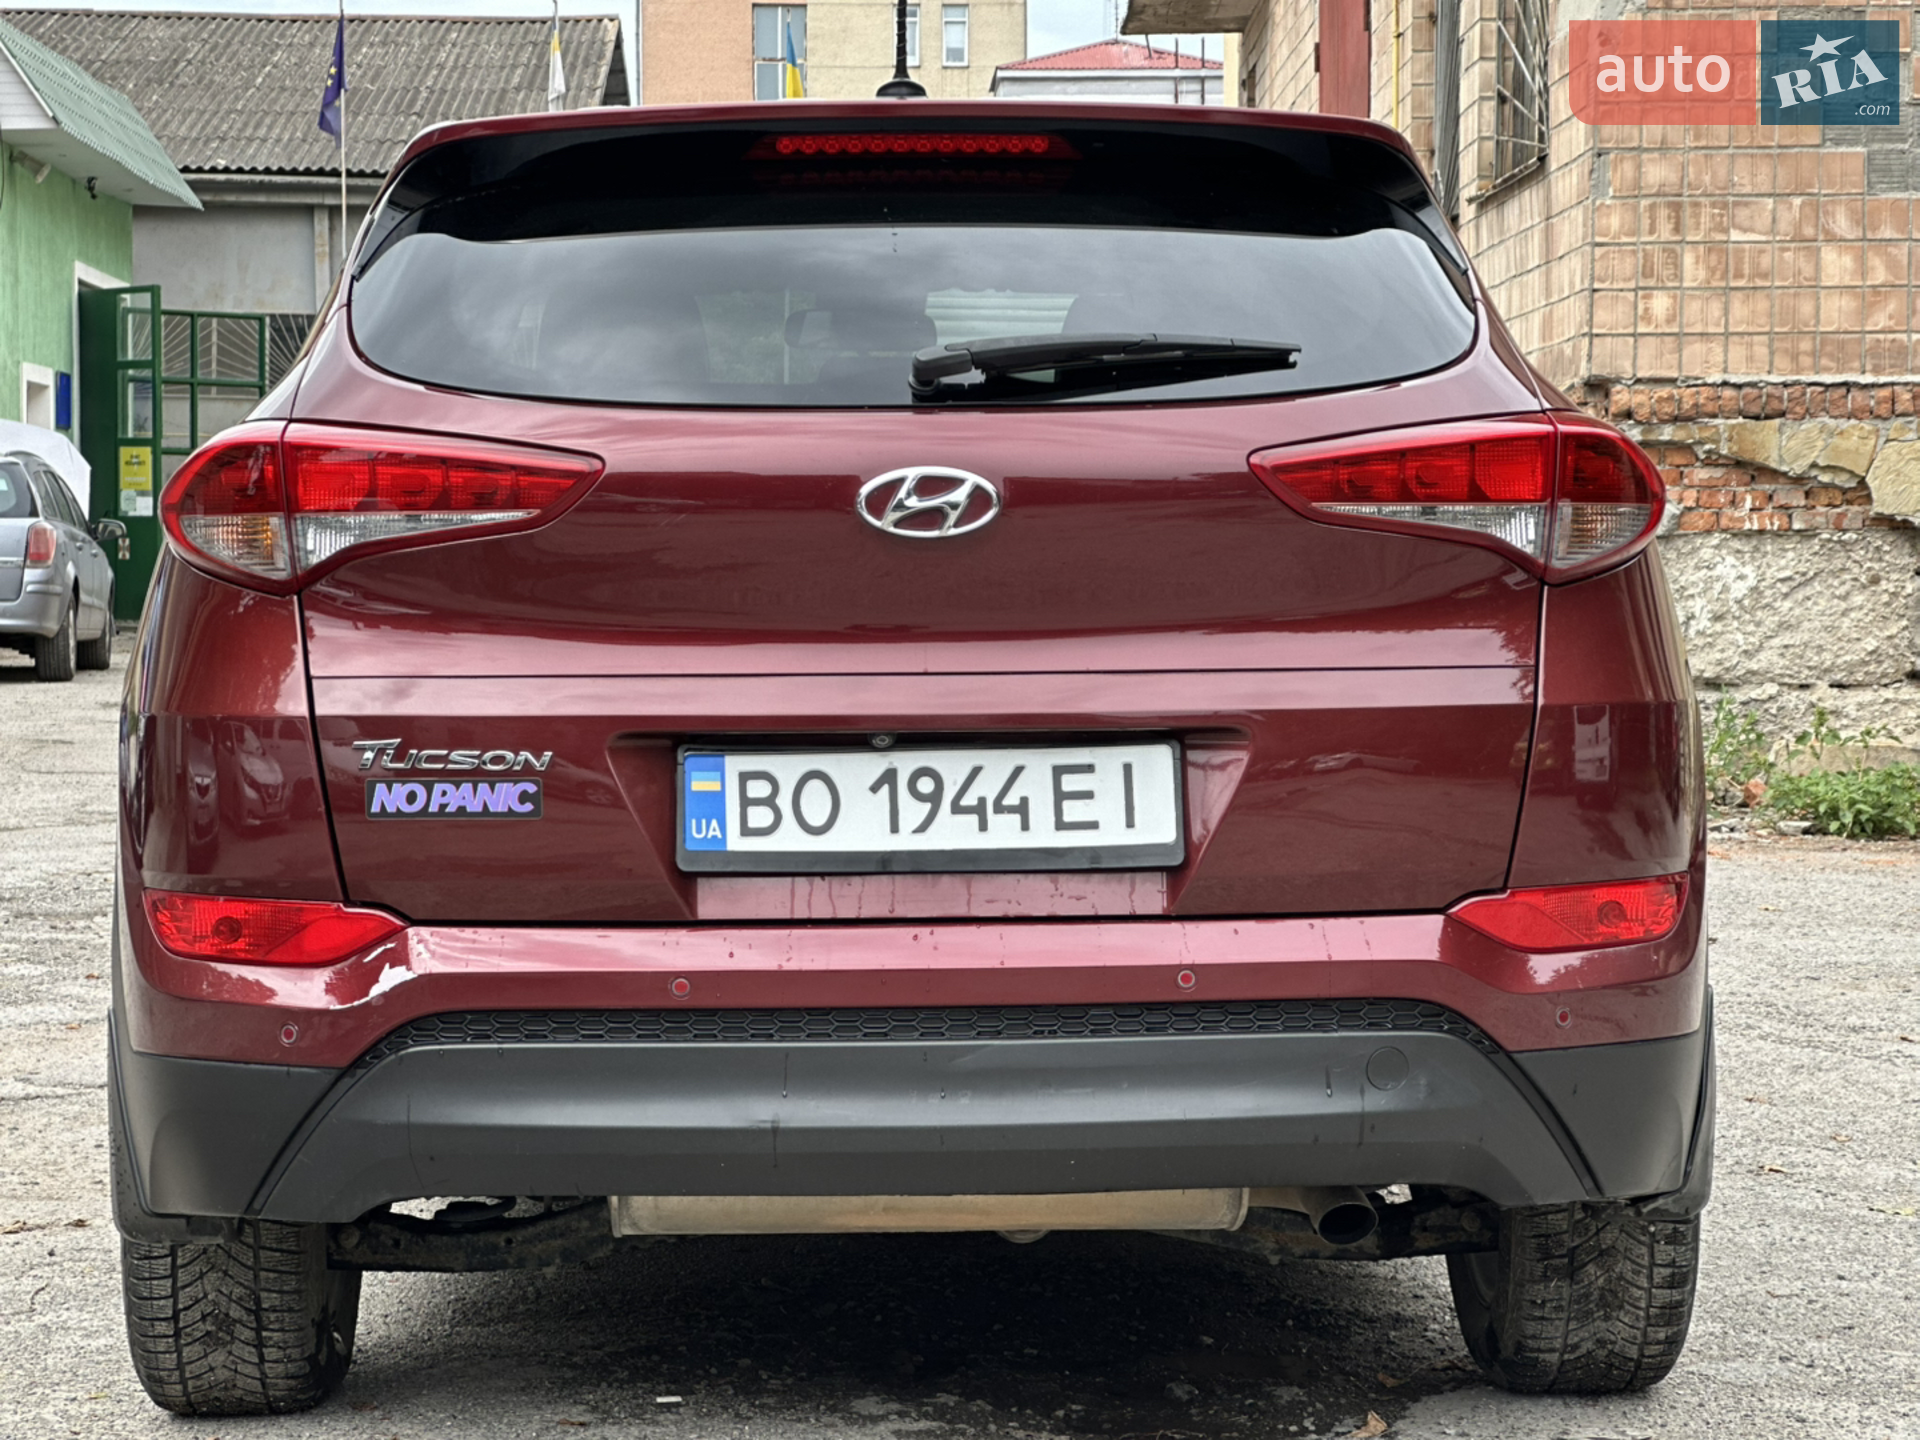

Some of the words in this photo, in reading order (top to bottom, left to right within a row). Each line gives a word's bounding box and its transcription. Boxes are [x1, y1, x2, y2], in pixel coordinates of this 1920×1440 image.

[370, 782, 427, 813] NO
[428, 782, 539, 813] PANIC
[738, 769, 841, 837] BO
[868, 765, 1030, 834] 1944
[1051, 762, 1135, 831] EI
[691, 818, 722, 839] UA
